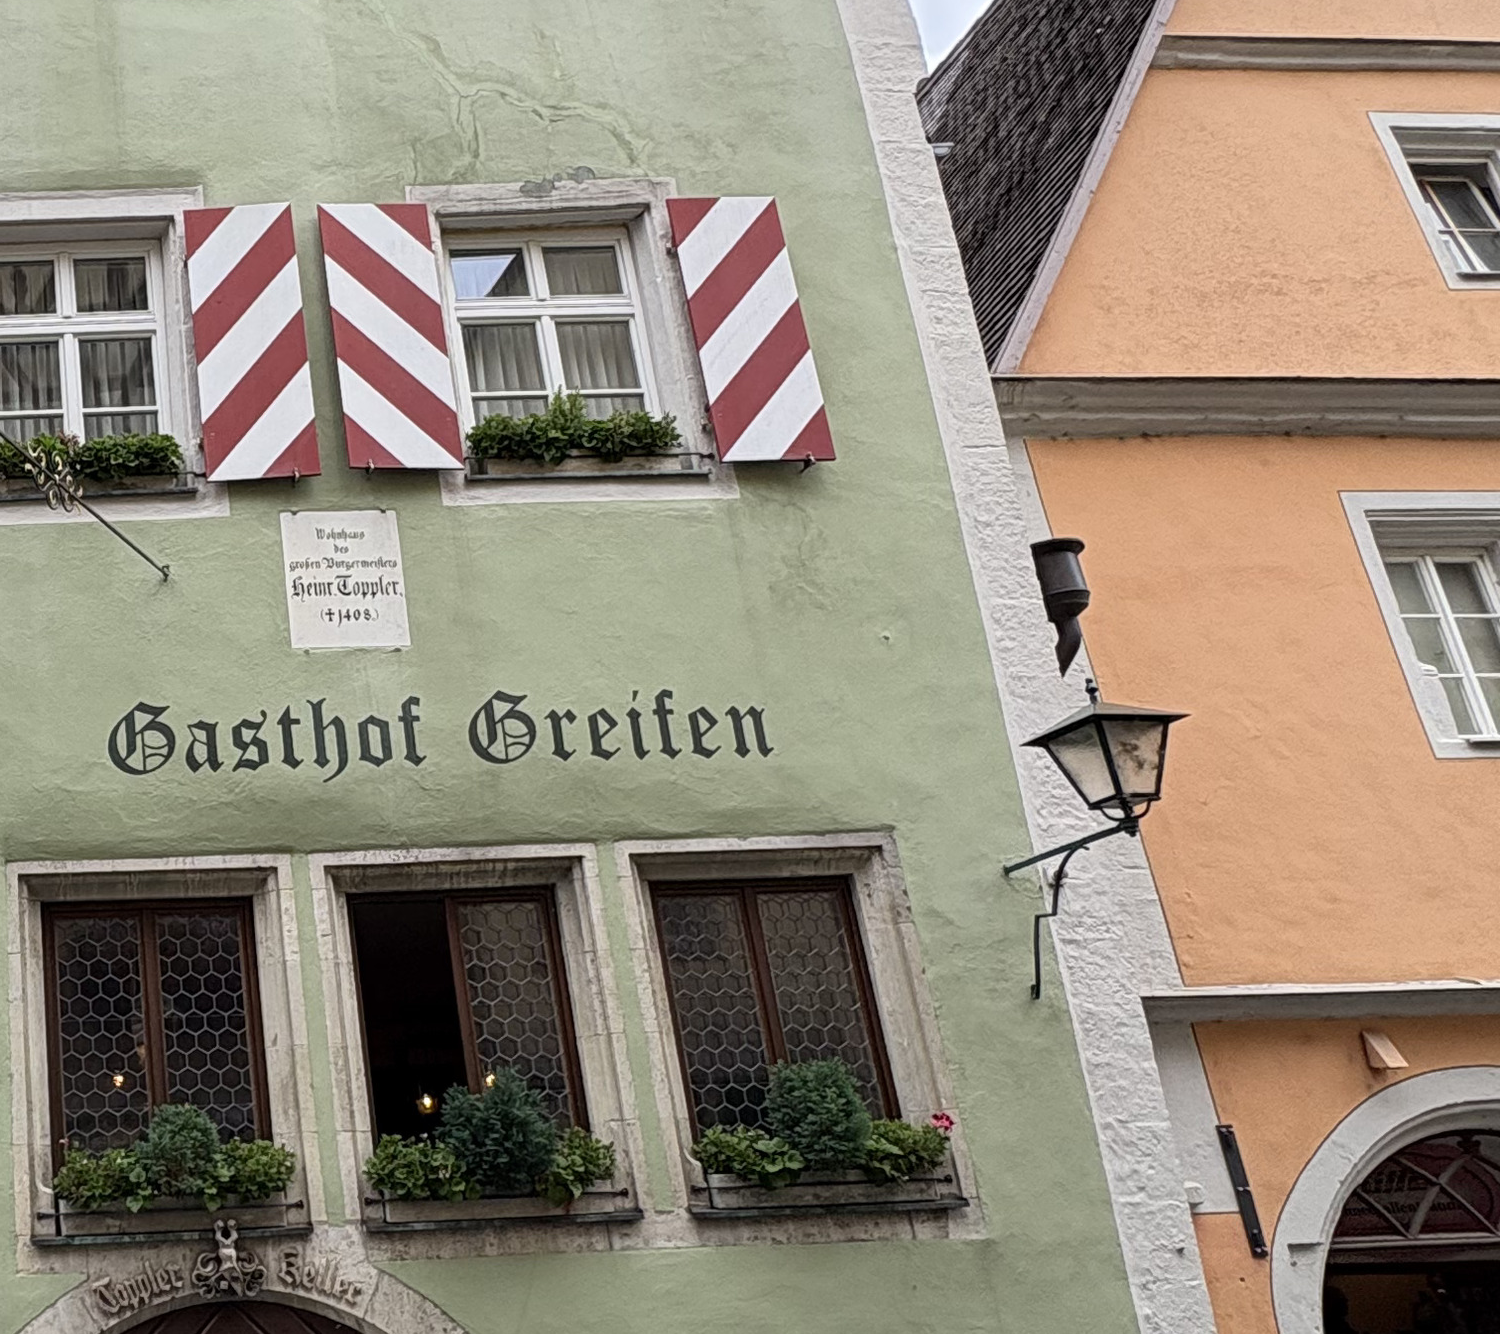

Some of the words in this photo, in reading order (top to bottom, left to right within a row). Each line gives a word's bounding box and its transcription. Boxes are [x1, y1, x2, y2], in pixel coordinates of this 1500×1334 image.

[333, 543, 349, 554] des
[107, 695, 428, 783] Gasthof
[467, 689, 776, 765] Greifen
[93, 1260, 184, 1313] Toppler
[278, 1247, 363, 1305] Keller
